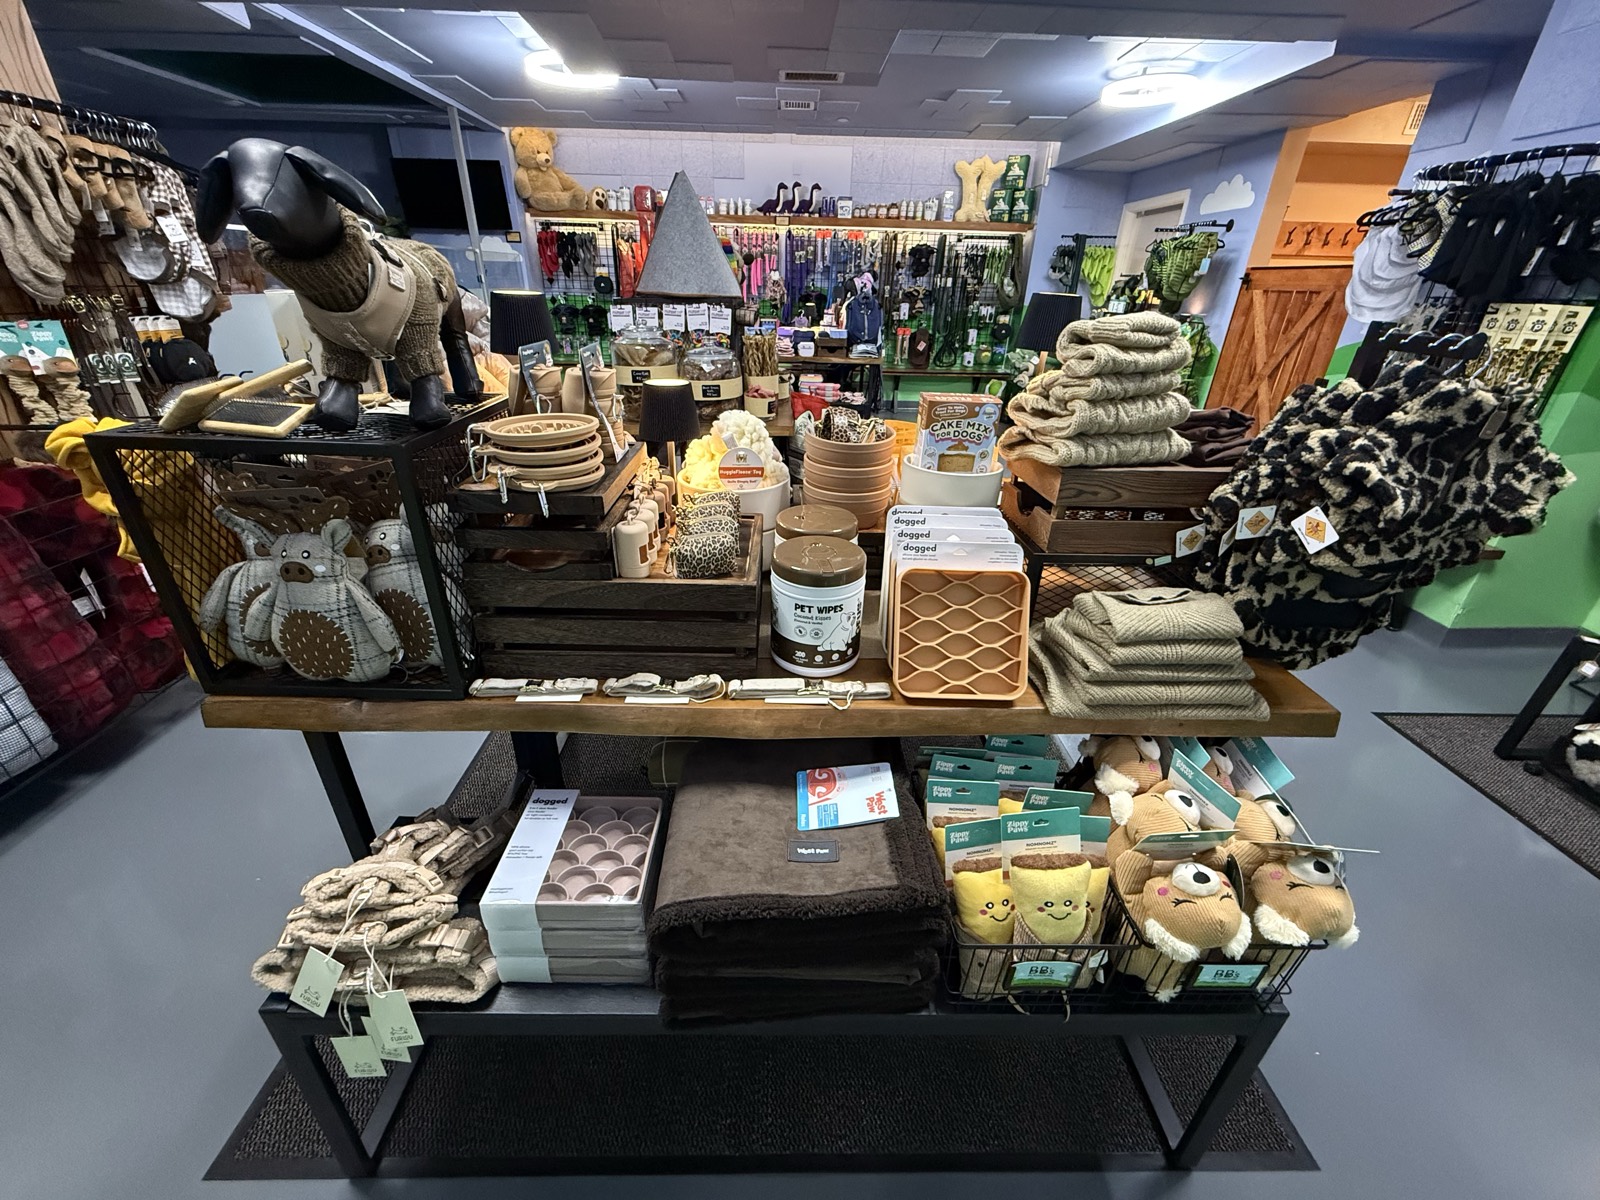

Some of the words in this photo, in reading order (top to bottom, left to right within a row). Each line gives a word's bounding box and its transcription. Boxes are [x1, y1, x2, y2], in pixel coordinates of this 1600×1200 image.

[931, 420, 963, 432] CAKE
[966, 421, 992, 435] MIX
[936, 431, 951, 439] FOR
[953, 430, 983, 442] DOGS
[894, 517, 927, 527] dogged
[898, 530, 931, 540] dogged
[903, 543, 937, 554] dogged
[794, 602, 814, 614] PET
[816, 603, 844, 615] WIPES
[936, 760, 955, 768] Zippy
[998, 763, 1016, 771] Zippy
[932, 785, 953, 793] Zippy
[532, 797, 568, 806] dogged
[1031, 793, 1049, 801] Zippy
[865, 796, 875, 814] Paw
[874, 791, 888, 815] West
[1006, 819, 1029, 829] Zippy
[950, 830, 970, 839] Zippy
[1007, 825, 1029, 834] Paws
[950, 836, 969, 844] Paws
